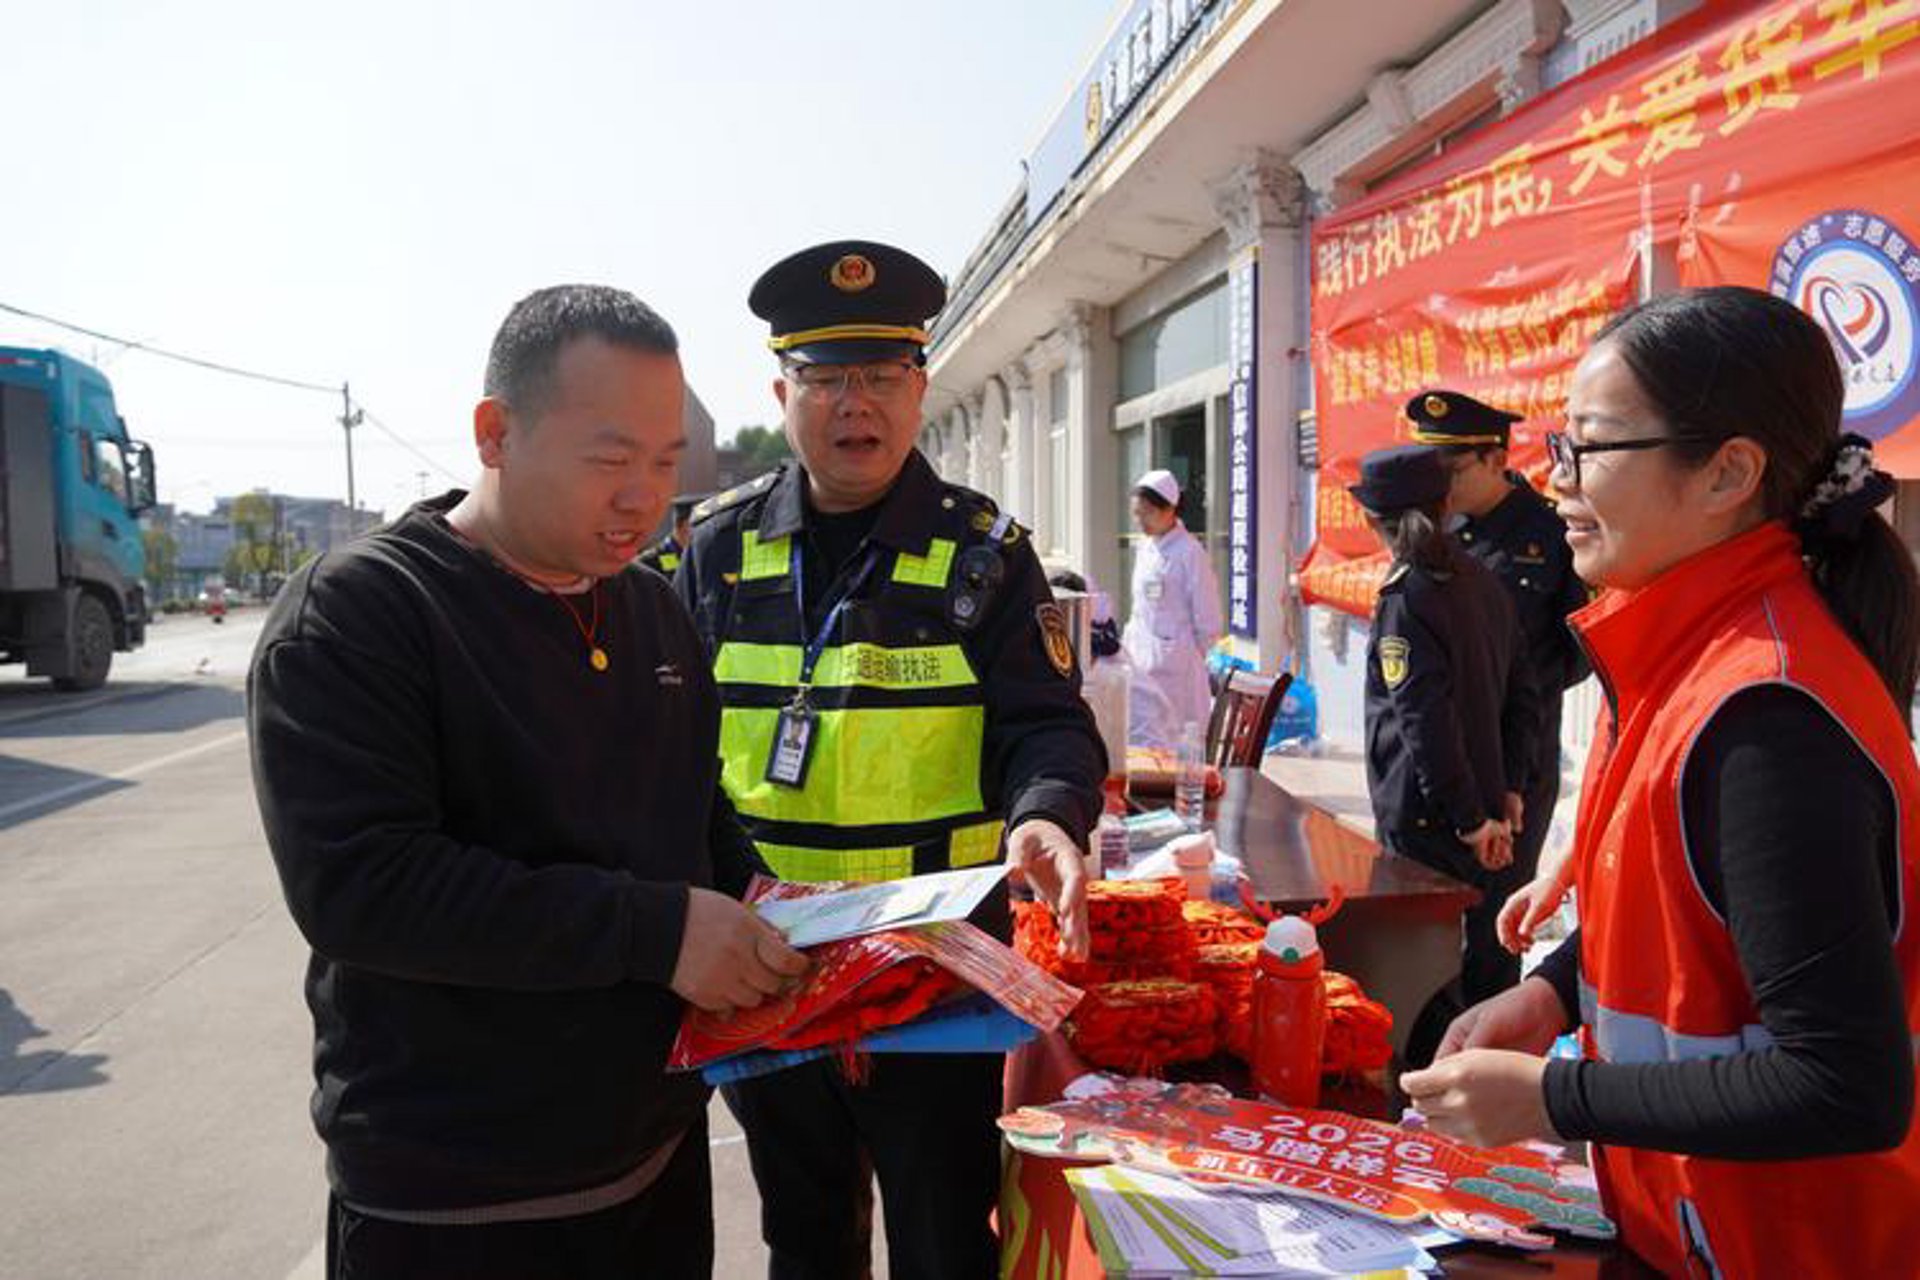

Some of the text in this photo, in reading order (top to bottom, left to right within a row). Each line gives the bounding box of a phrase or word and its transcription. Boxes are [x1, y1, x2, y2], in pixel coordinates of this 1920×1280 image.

[1210, 1125, 1451, 1192] 马踏祥云
[1262, 1114, 1435, 1163] 2026
